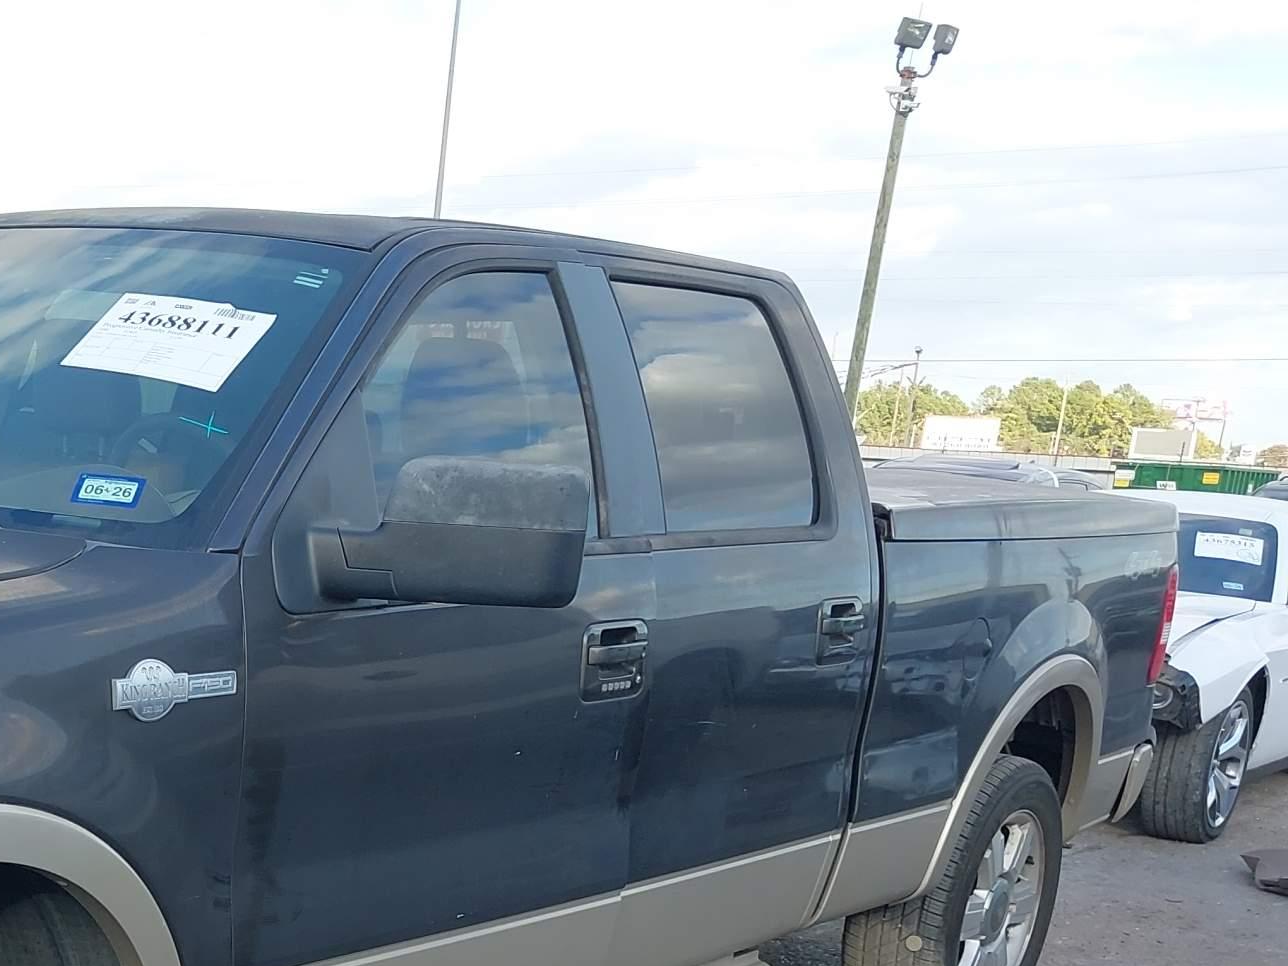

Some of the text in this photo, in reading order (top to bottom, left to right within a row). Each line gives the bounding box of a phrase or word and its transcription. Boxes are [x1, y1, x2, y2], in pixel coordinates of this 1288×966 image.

[118, 310, 241, 340] 43688111
[84, 484, 132, 498] 06 26
